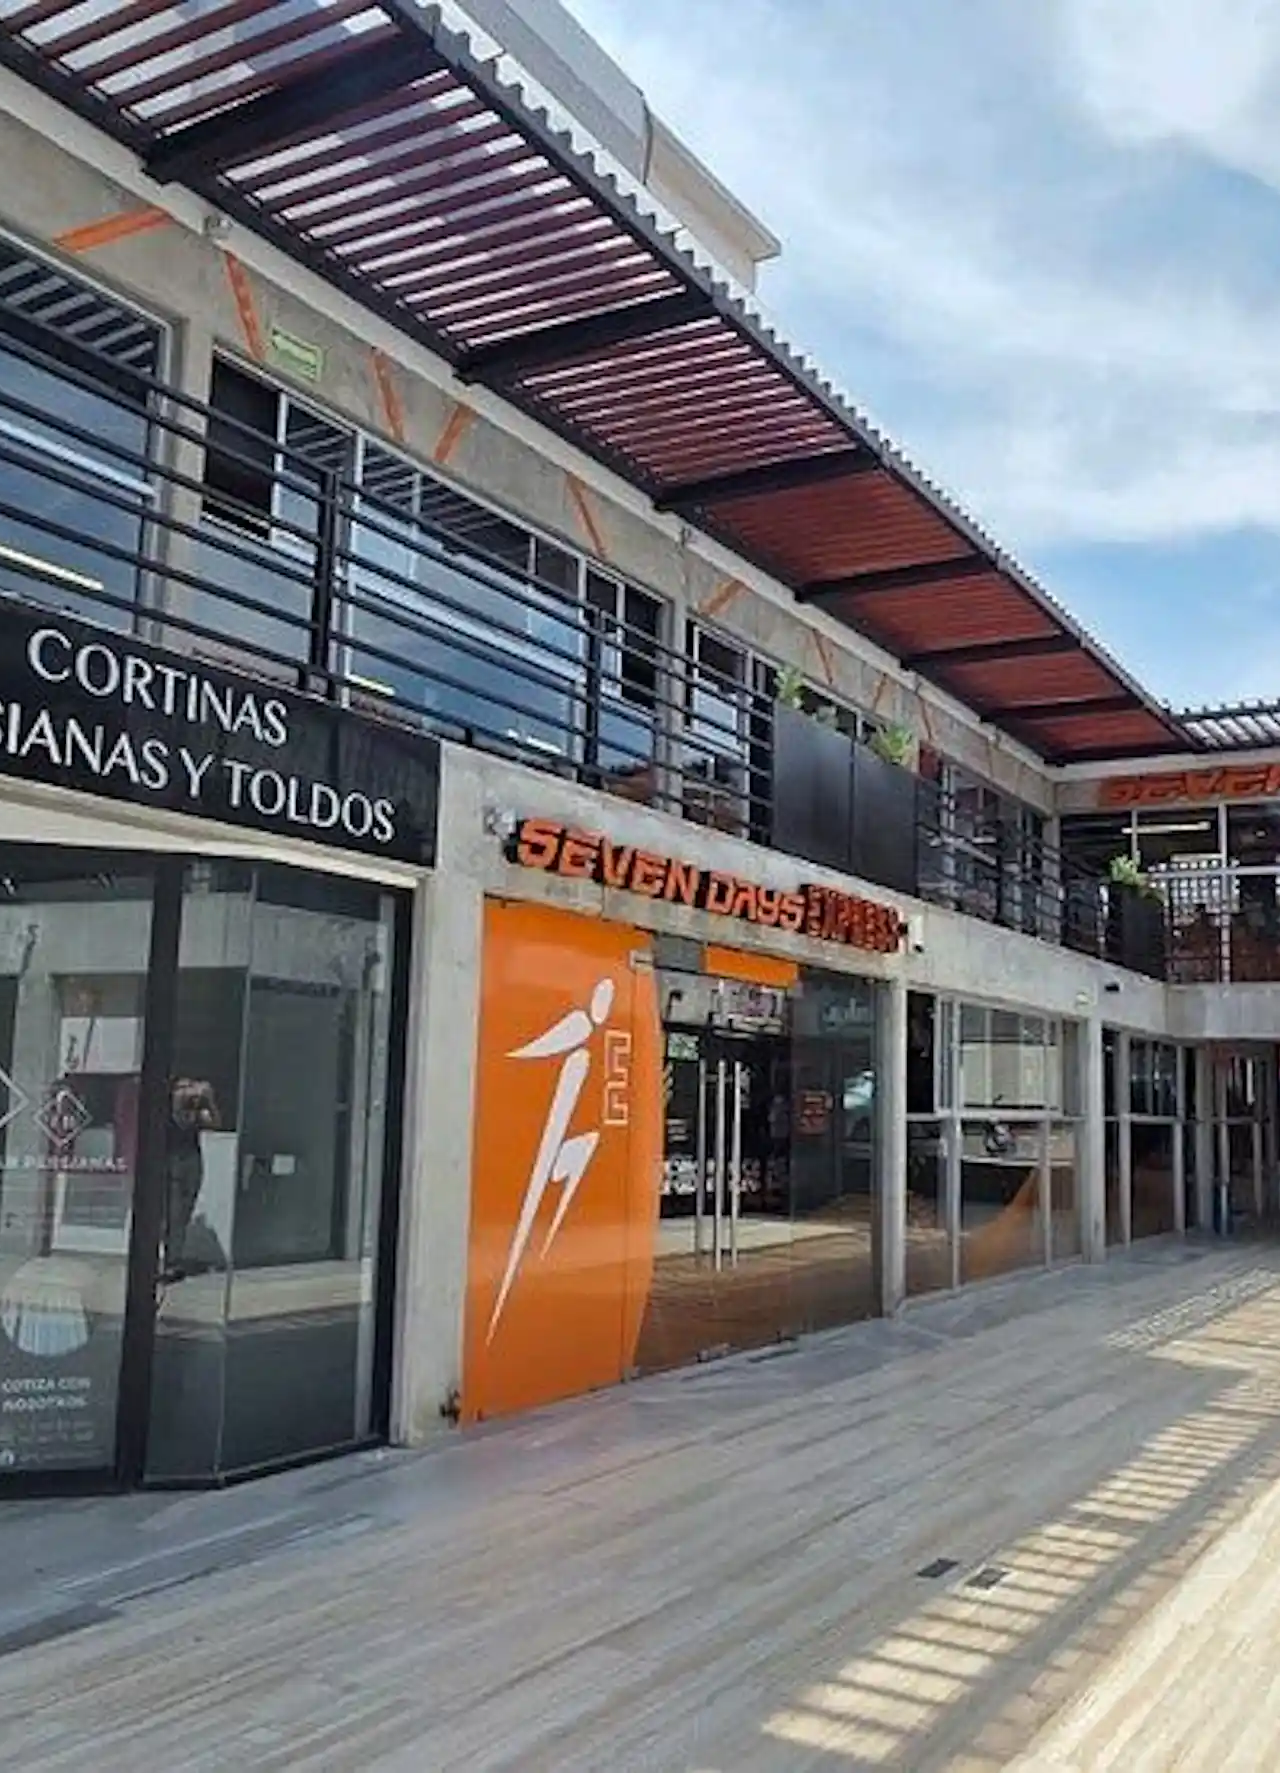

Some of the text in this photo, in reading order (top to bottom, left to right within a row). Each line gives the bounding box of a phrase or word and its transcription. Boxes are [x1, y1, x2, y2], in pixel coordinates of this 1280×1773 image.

[27, 628, 287, 747] CORTINAS
[178, 747, 215, 799] Y
[223, 757, 396, 844] TOLDOS
[517, 817, 701, 911] SEVEN
[704, 870, 805, 932] DAYS
